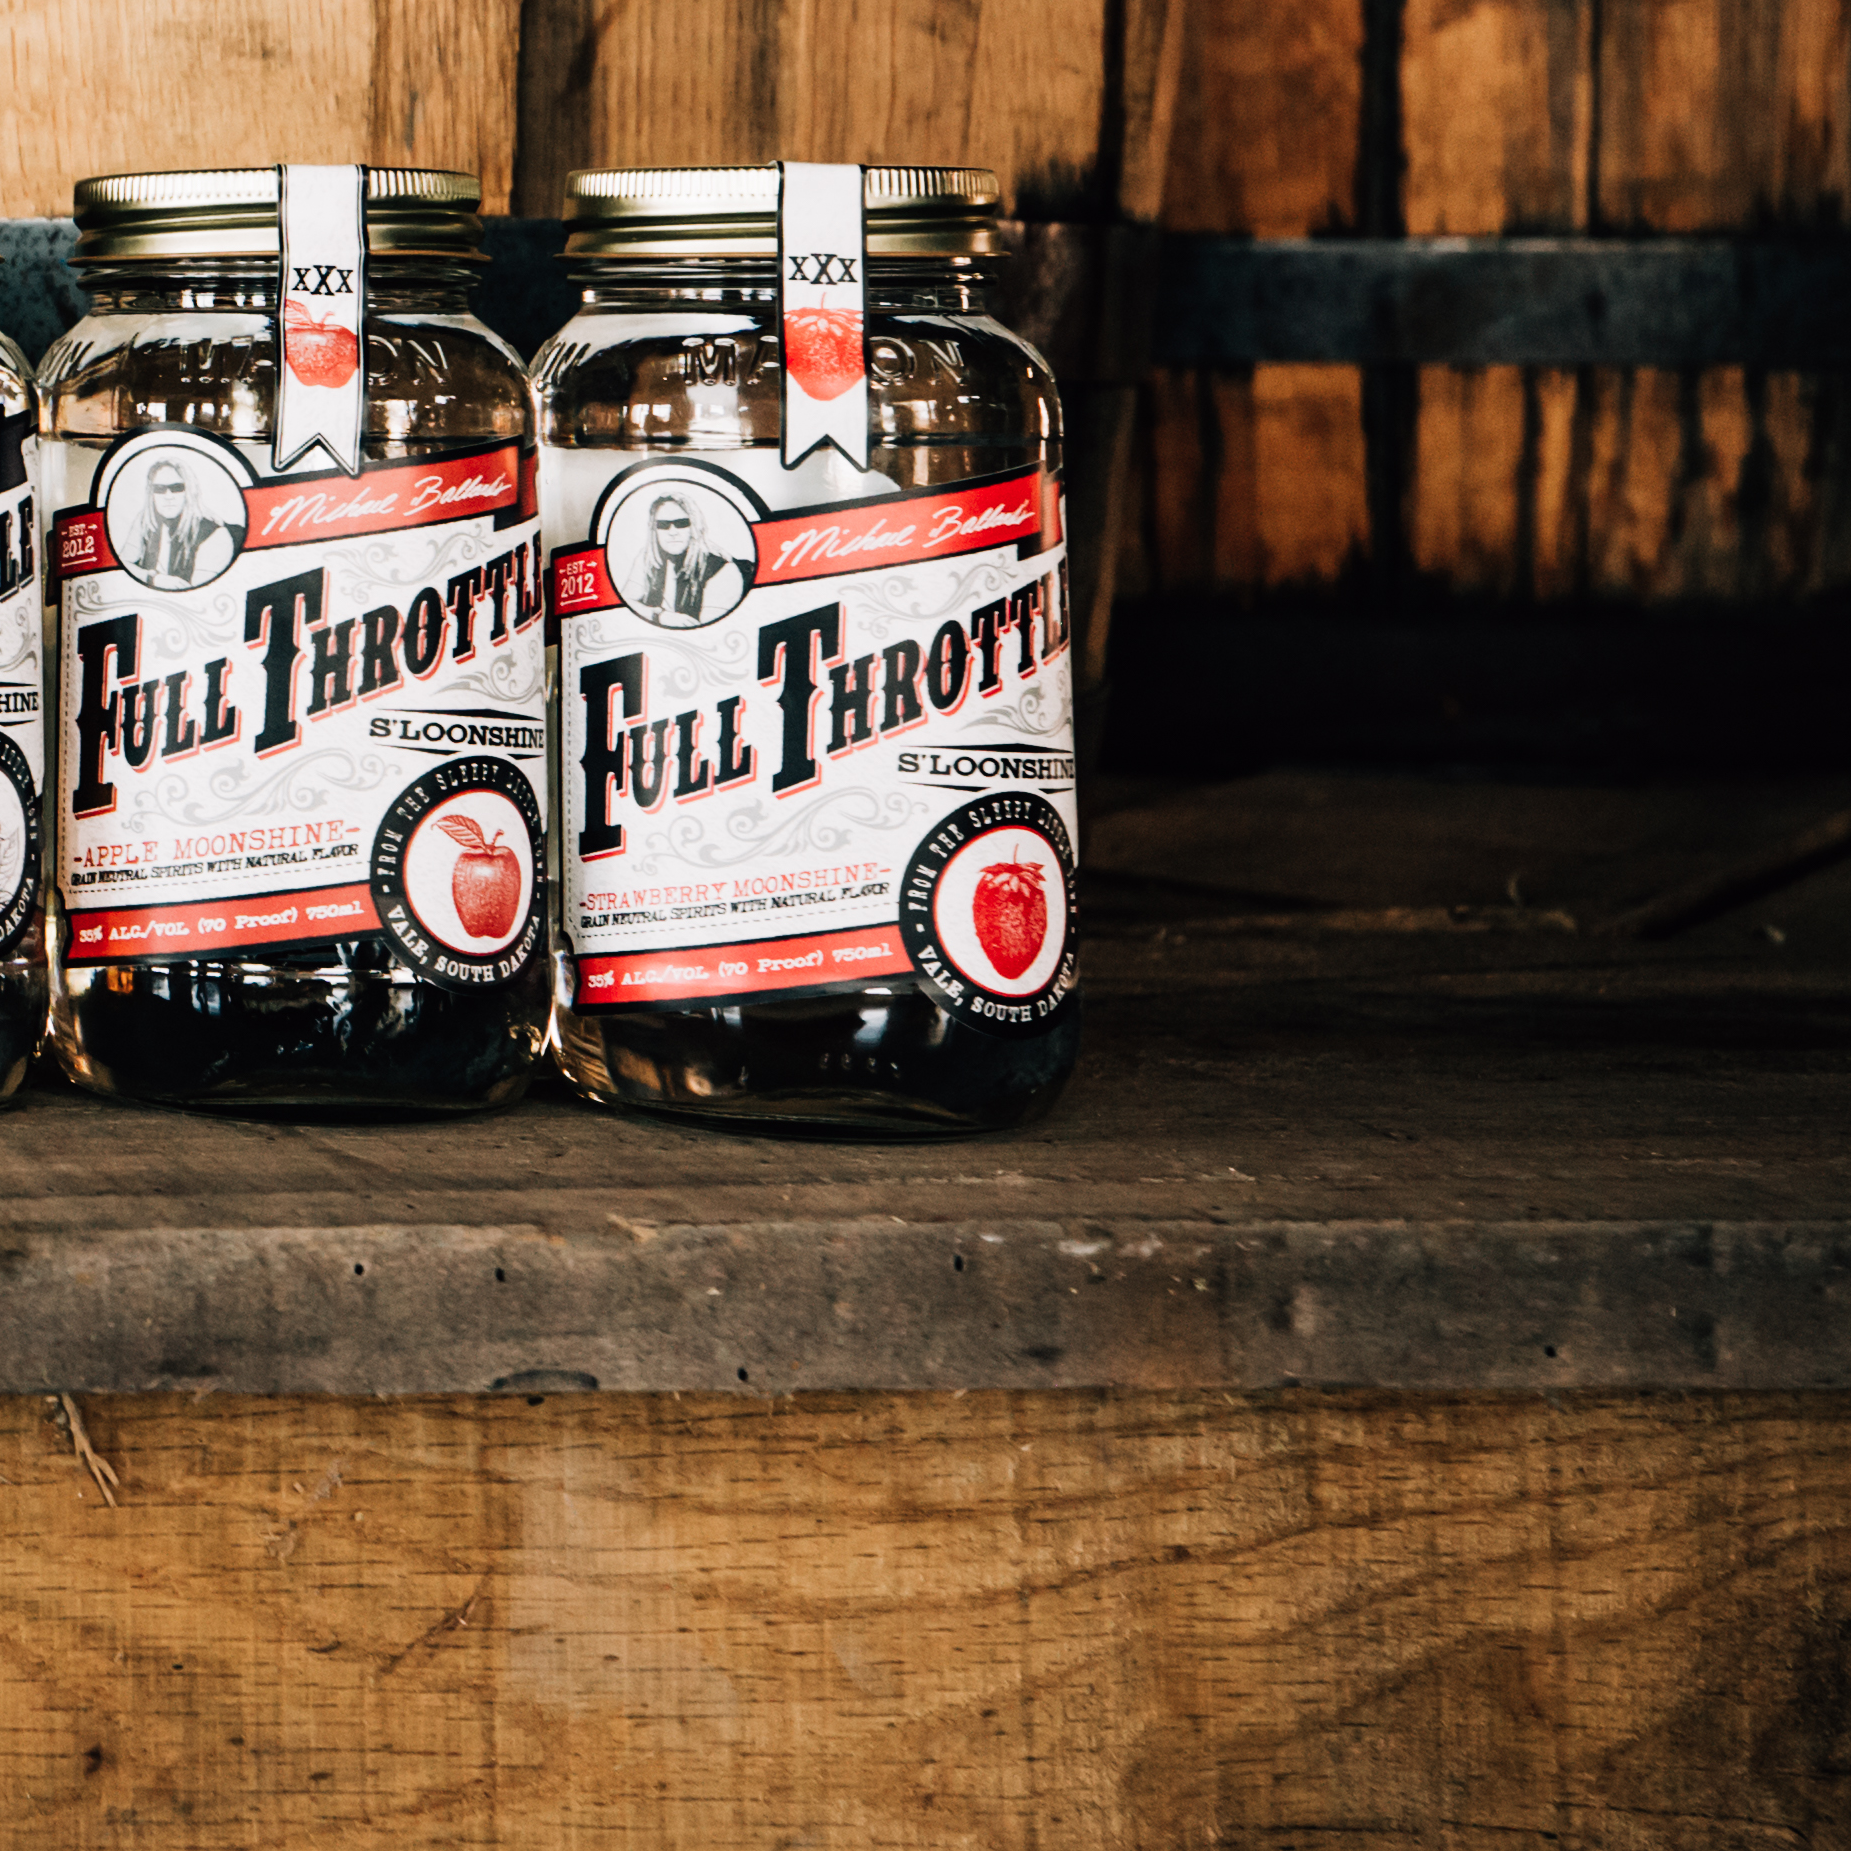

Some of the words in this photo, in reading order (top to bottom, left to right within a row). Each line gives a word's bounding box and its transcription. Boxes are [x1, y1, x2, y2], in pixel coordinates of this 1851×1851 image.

[62, 537, 95, 558] 2012
[560, 575, 595, 597] 2012
[73, 613, 241, 820] FULL
[579, 652, 757, 863] FULL
[198, 917, 227, 935] (70
[234, 907, 298, 929] Proof)
[306, 900, 365, 921] 750ml
[388, 905, 429, 964] VALE,
[434, 955, 495, 983] SOUTH
[500, 915, 540, 978] DAKOTA
[587, 969, 614, 988] 35%
[718, 960, 748, 977] (70
[757, 950, 824, 973] Proof)
[832, 943, 894, 965] 750ml
[918, 945, 965, 1006] VALE,
[970, 996, 1032, 1023] SOUTH
[1039, 953, 1074, 1017] DAKOTA
